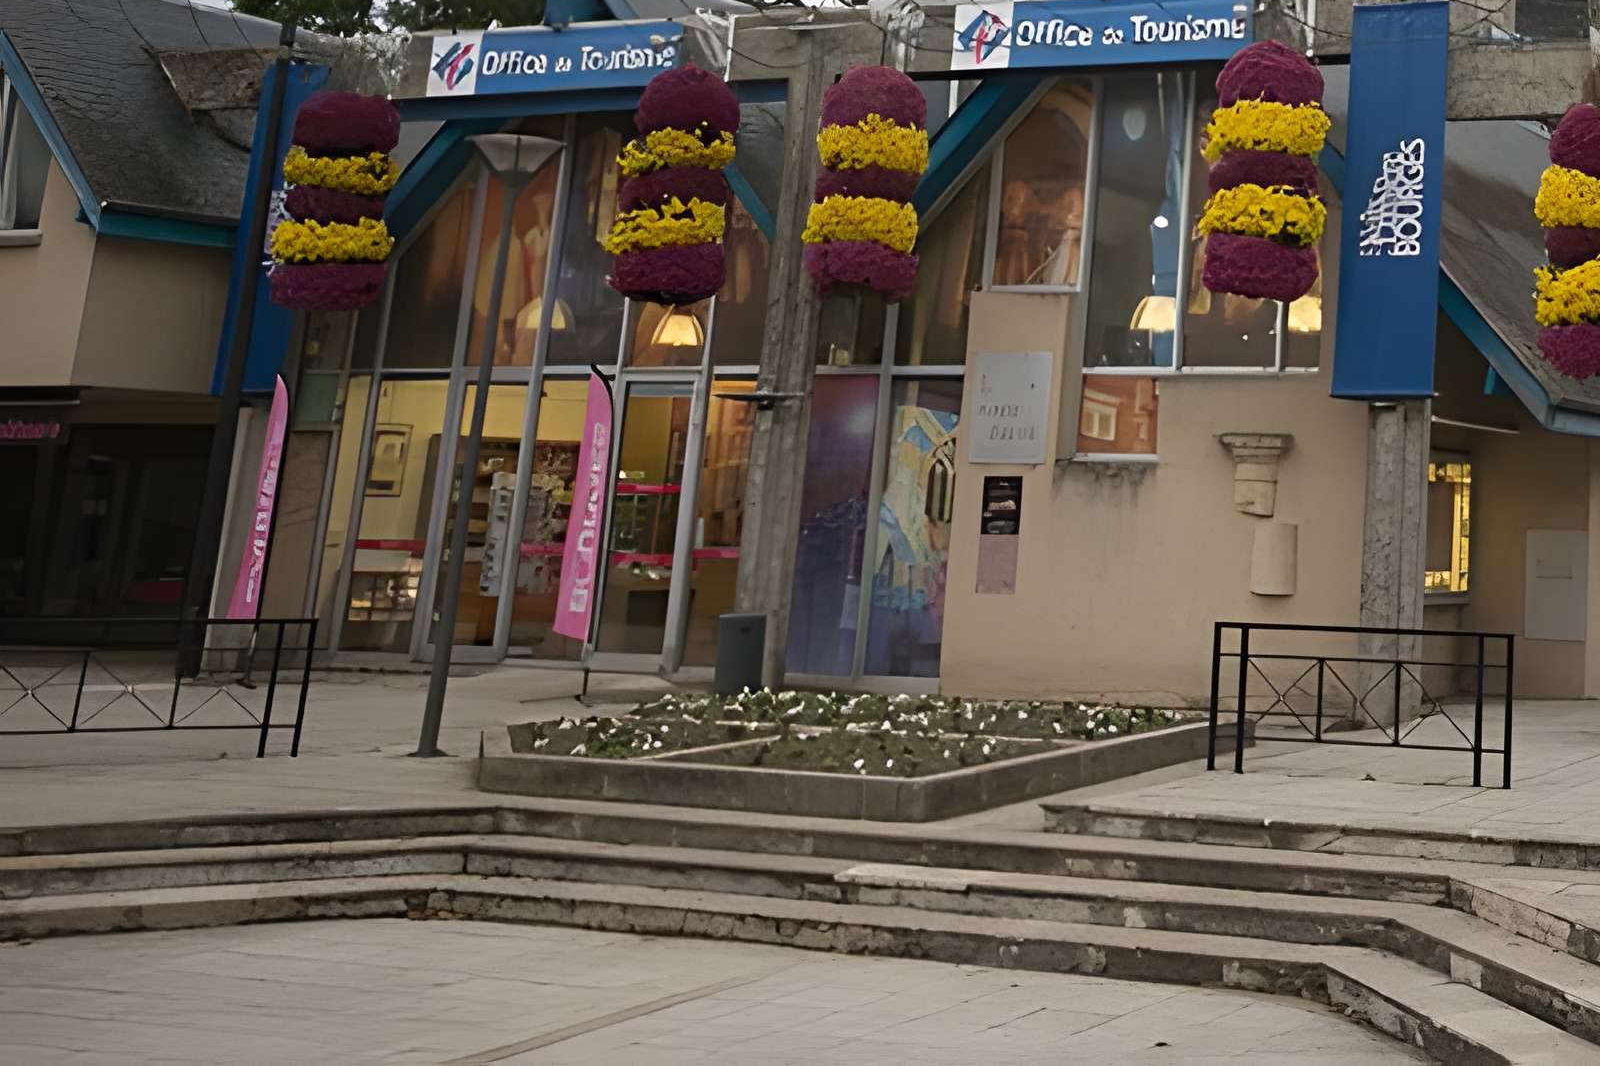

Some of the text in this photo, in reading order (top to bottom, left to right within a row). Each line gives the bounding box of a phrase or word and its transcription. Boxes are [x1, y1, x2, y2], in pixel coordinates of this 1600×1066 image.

[1015, 19, 1093, 47] Office
[1129, 14, 1245, 43] Tourisme
[481, 50, 548, 76] Office
[581, 43, 676, 71] Tourisme
